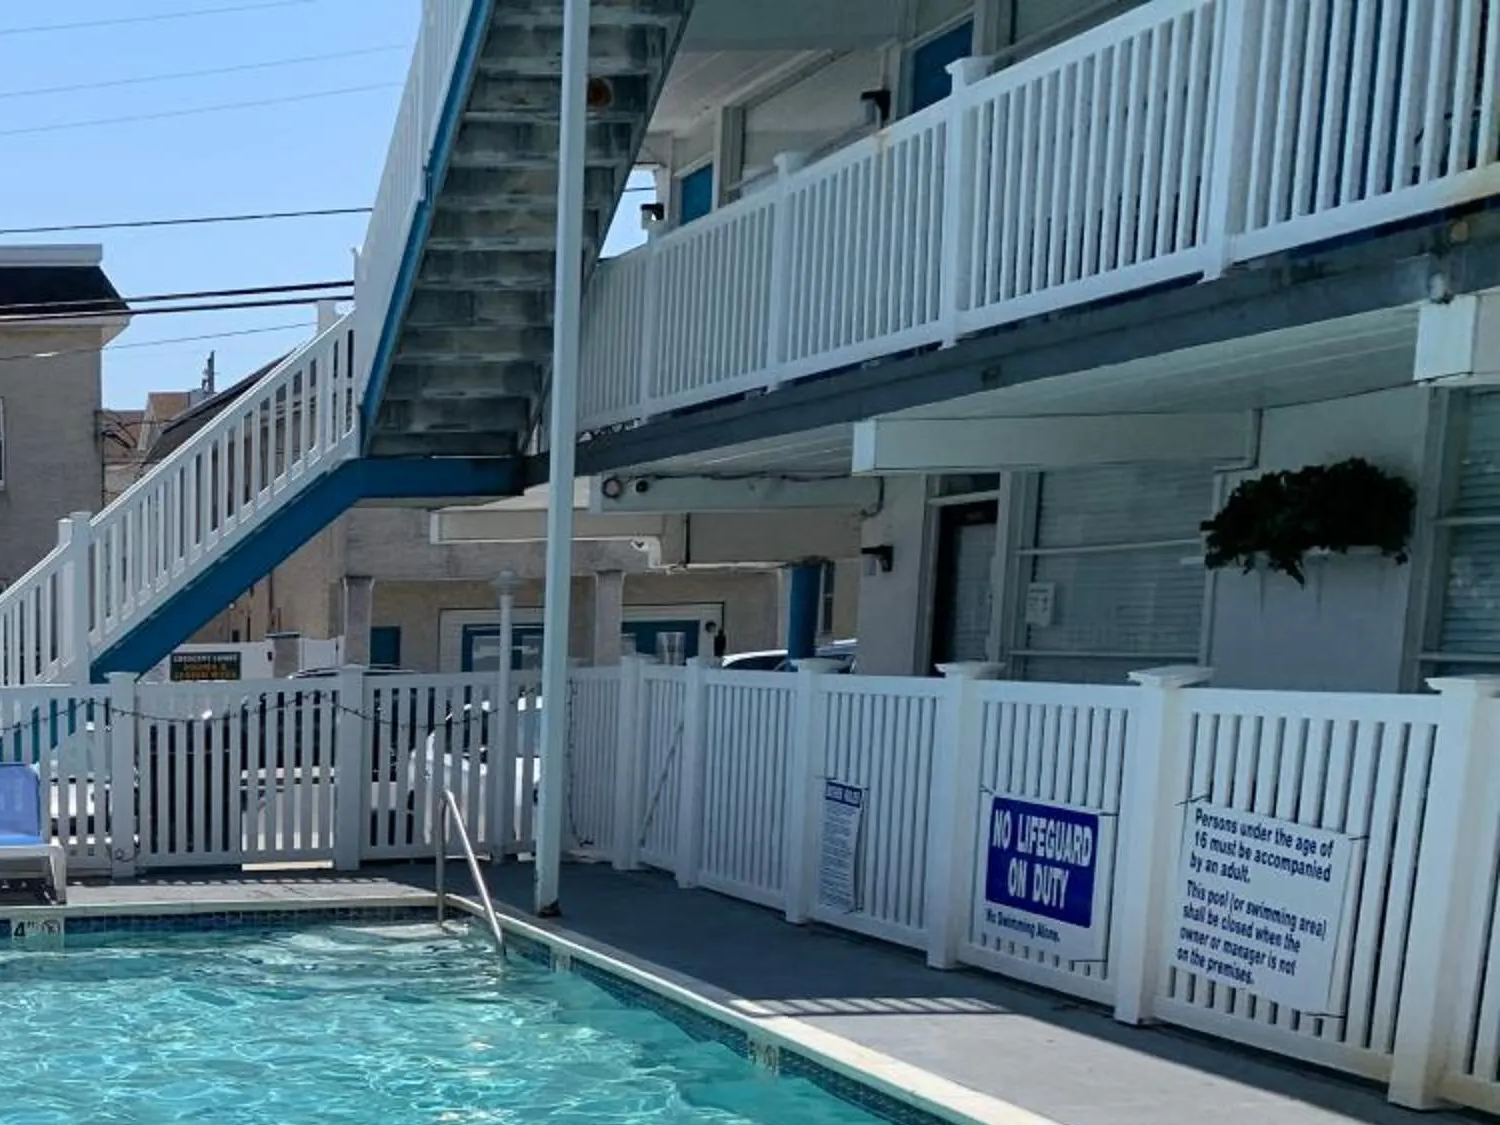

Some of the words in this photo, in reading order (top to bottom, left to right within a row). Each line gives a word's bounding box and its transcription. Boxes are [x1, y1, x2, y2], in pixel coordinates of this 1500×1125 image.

[993, 809, 1012, 849] NO
[1017, 813, 1093, 867] LIFEGUARD
[1194, 831, 1208, 849] 16
[1209, 837, 1237, 856] must
[1238, 840, 1251, 860] be
[1253, 849, 1333, 882] accompanied
[1195, 808, 1237, 834] Persons
[1240, 821, 1273, 842] under
[1274, 827, 1294, 848] the
[1295, 837, 1317, 856] age
[1320, 839, 1335, 858] of
[1008, 857, 1028, 898] ON
[1032, 863, 1070, 909] DUTY
[1189, 852, 1203, 873] by
[1205, 859, 1219, 874] an
[1220, 862, 1251, 884] adult.
[1183, 902, 1207, 923] shall
[1207, 909, 1220, 928] be
[1221, 914, 1254, 939] closed
[1255, 926, 1282, 948] when
[1283, 932, 1301, 954] the
[1187, 879, 1206, 901] This
[1207, 889, 1229, 908] pool
[1245, 900, 1297, 933] swimming
[1177, 947, 1190, 961] on
[1189, 949, 1207, 968] the
[1206, 957, 1254, 985] premises.
[1180, 926, 1209, 946] owner
[1210, 936, 1222, 950] or
[1223, 940, 1267, 966] manager
[1267, 950, 1278, 970] is
[1278, 957, 1297, 977] not
